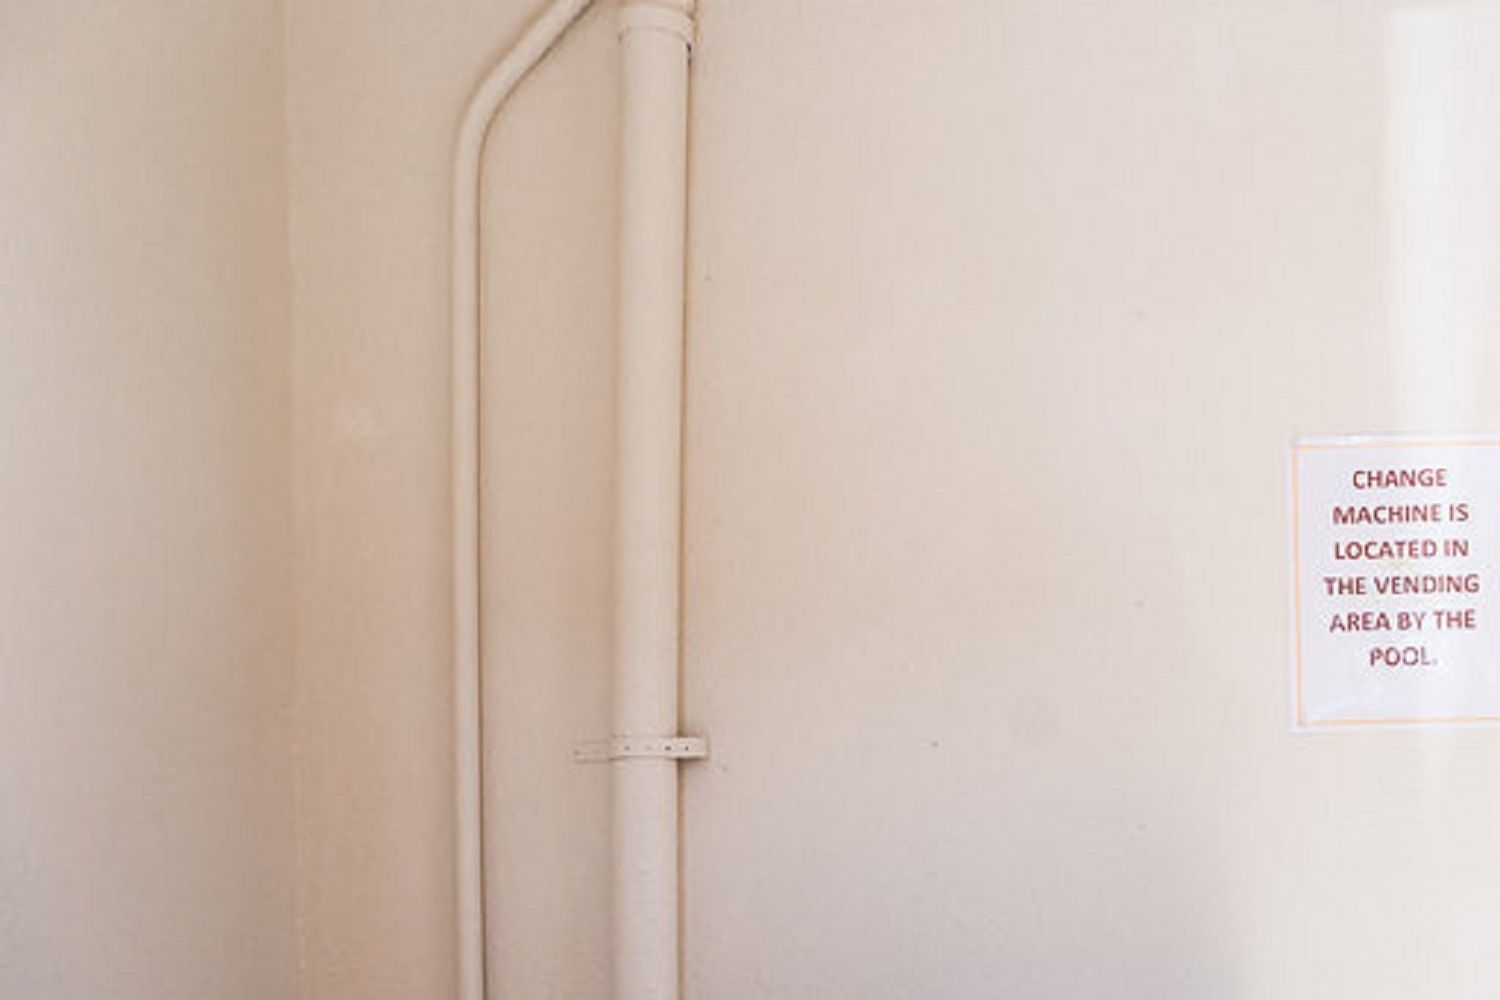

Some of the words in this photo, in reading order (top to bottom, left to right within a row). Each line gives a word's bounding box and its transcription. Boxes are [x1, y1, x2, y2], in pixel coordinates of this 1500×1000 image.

[1352, 468, 1448, 489] CHANGE
[1332, 504, 1441, 524] MACHINE
[1448, 504, 1470, 522] IS
[1334, 540, 1437, 560] LOCATED
[1444, 539, 1469, 557] IN
[1323, 577, 1367, 596] THE
[1373, 574, 1480, 594] VENDING
[1330, 612, 1390, 632] AREA
[1396, 611, 1426, 630] BY
[1432, 609, 1476, 630] THE
